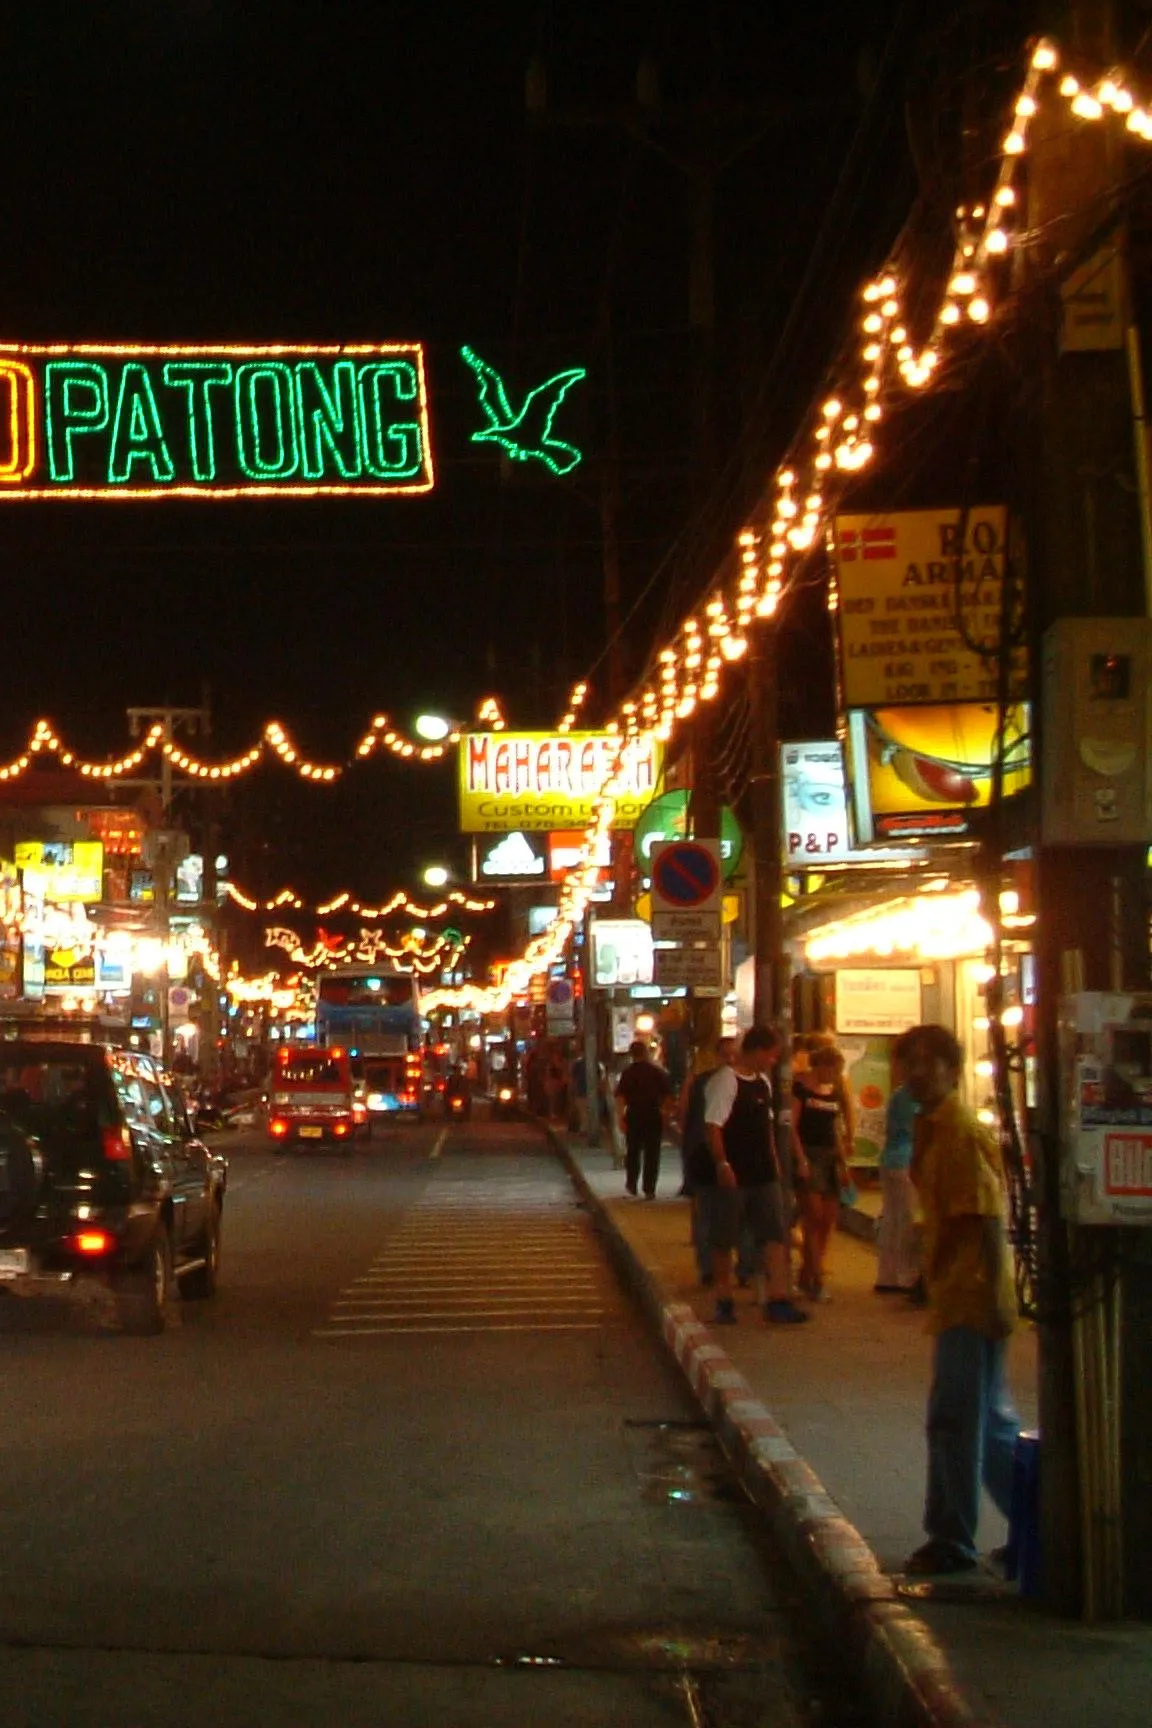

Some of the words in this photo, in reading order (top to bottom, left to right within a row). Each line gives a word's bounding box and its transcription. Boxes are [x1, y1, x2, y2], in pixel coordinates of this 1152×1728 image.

[44, 359, 425, 483] PATONG
[468, 736, 653, 793] MAHARAH
[477, 801, 573, 818] Custom
[579, 799, 648, 817] tlor
